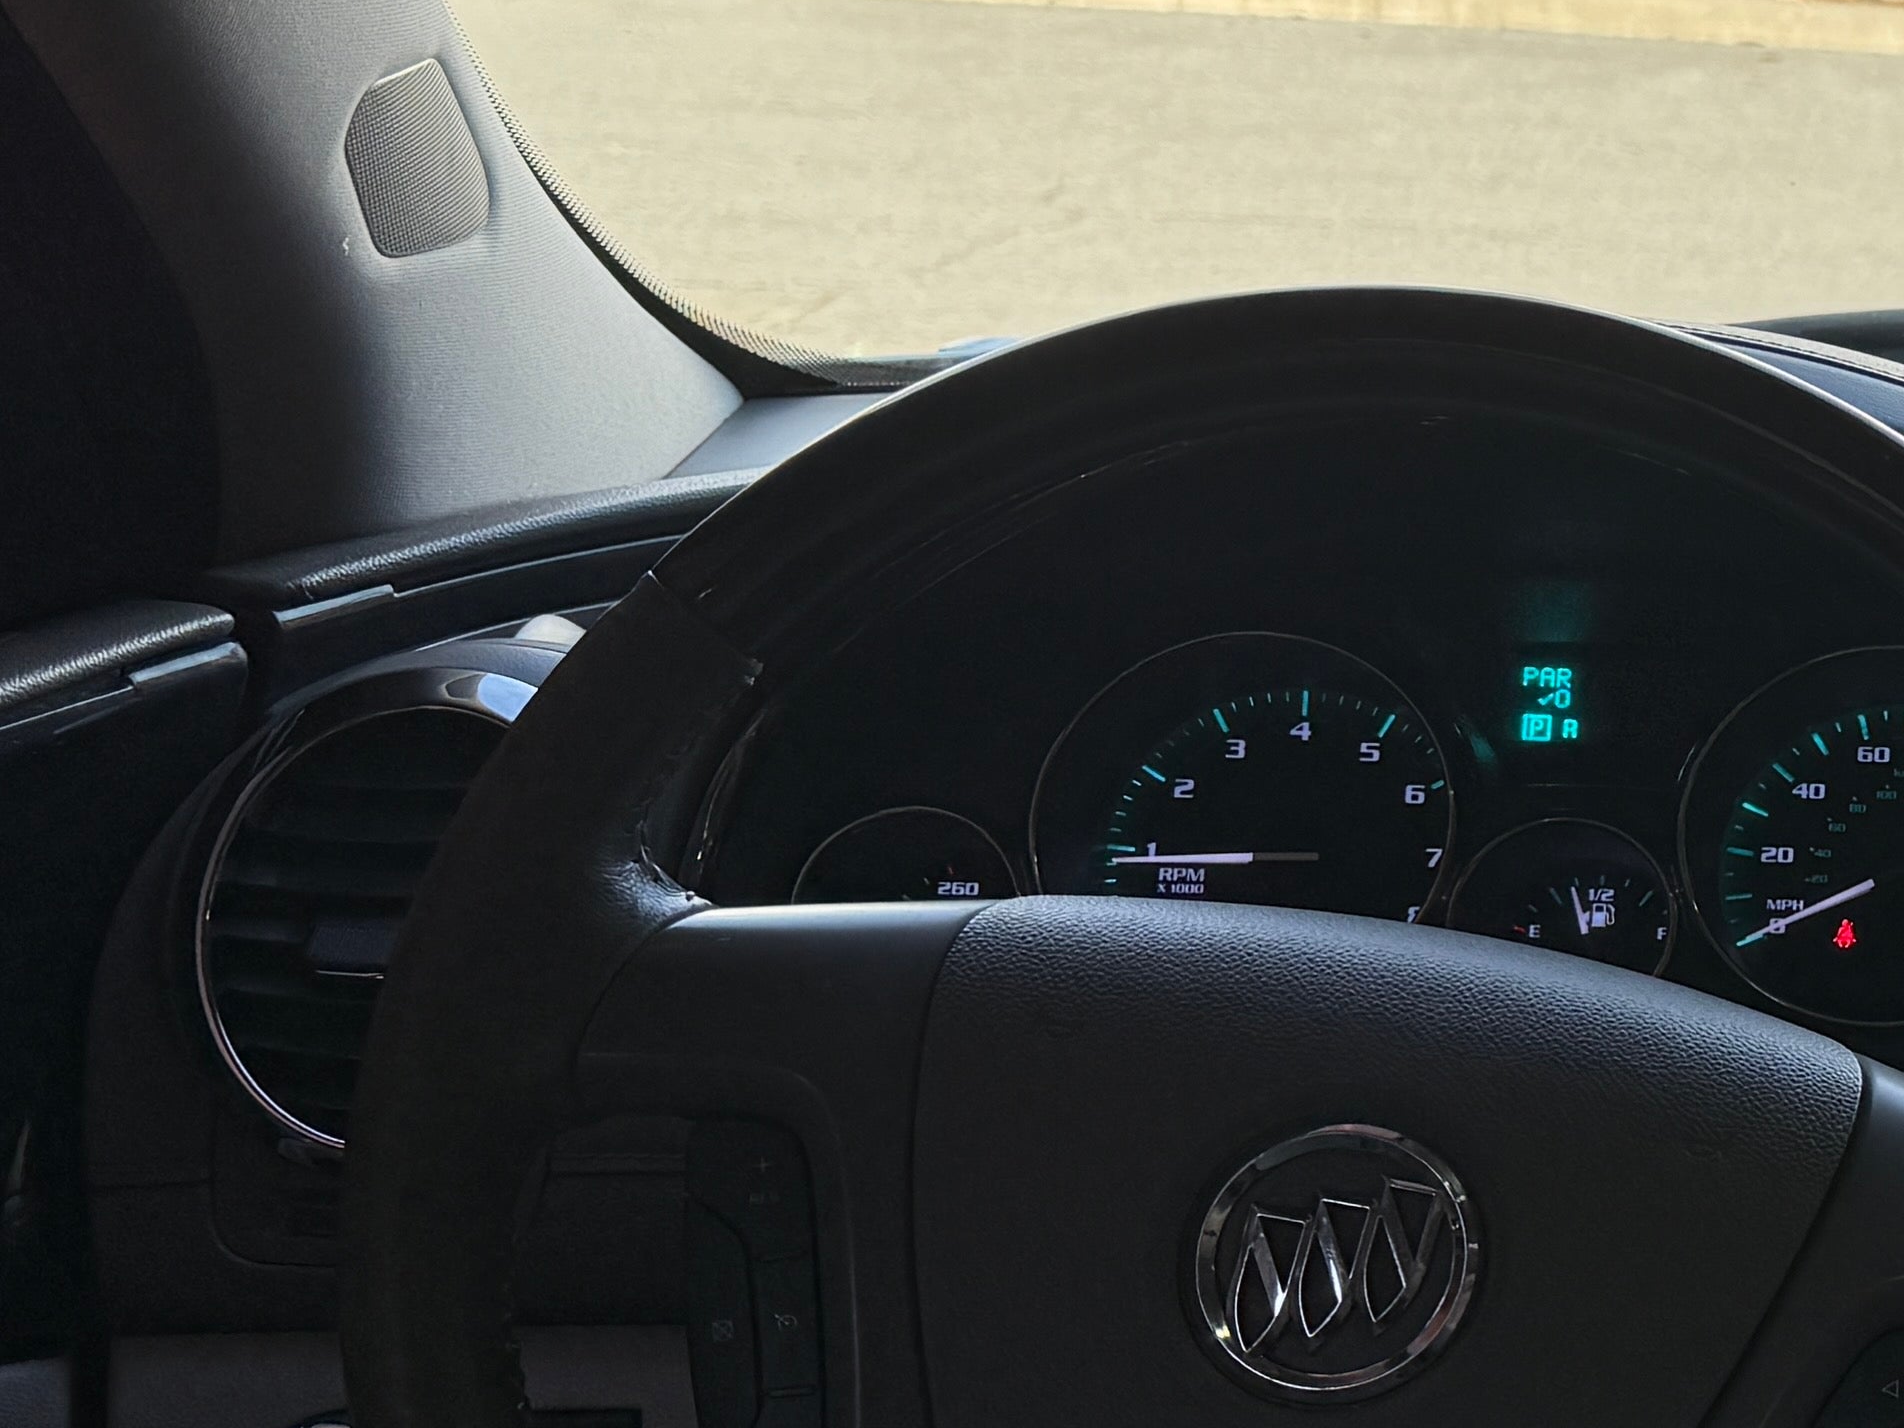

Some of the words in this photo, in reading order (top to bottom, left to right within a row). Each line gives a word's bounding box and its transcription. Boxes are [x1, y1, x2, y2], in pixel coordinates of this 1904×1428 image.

[1522, 666, 1573, 688] PAR
[1288, 721, 1312, 742] 4
[1224, 738, 1247, 760] 3
[1358, 741, 1381, 763] 5
[1855, 745, 1892, 764] 60
[1172, 777, 1195, 800] 2
[1403, 782, 1426, 805] 6
[1791, 781, 1828, 801] 40
[1425, 847, 1443, 869] 7
[1759, 845, 1795, 864] 20
[1157, 867, 1206, 883] RPM
[937, 880, 981, 897] 260
[1170, 882, 1206, 895] 1000
[1587, 887, 1616, 902] 1/2
[1765, 898, 1805, 911] MPH
[1528, 923, 1542, 939] E
[1656, 926, 1668, 941] F
